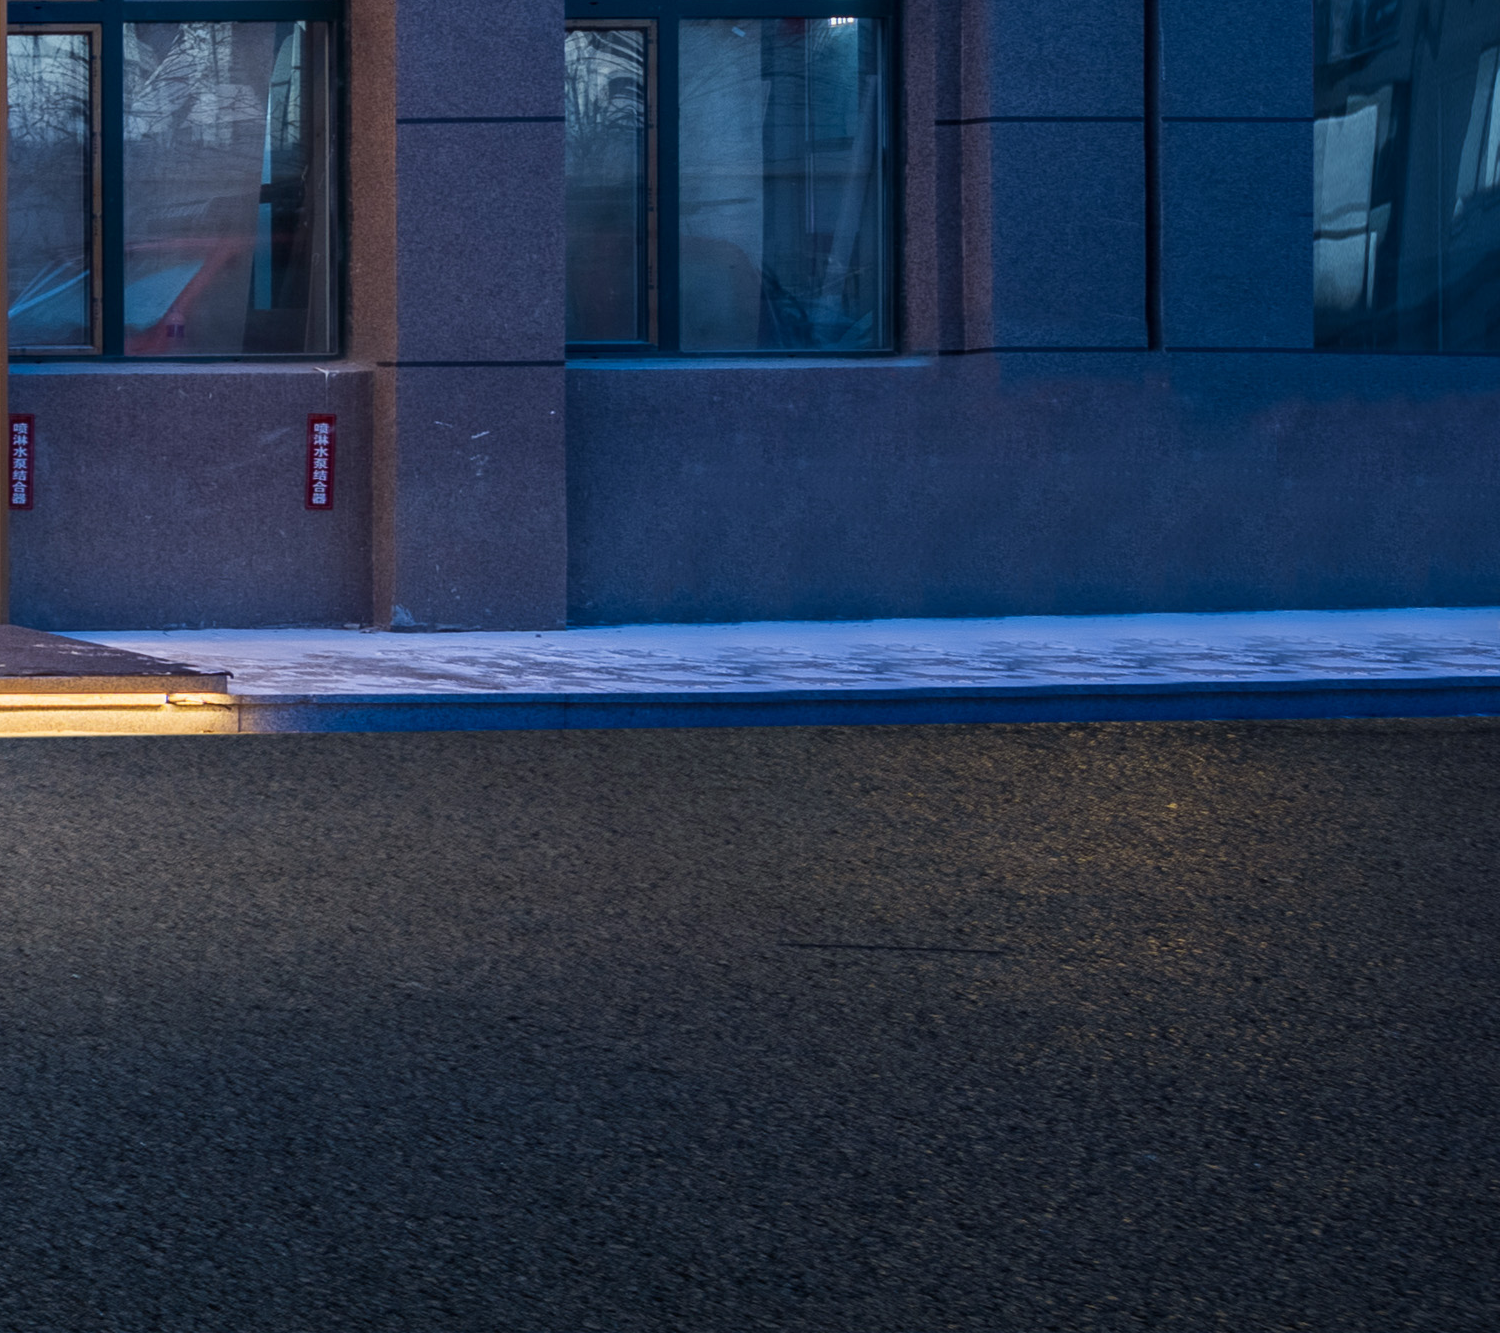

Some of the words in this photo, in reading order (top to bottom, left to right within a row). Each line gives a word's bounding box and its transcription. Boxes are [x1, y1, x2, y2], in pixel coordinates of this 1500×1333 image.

[12, 422, 28, 504] 喷淋水泵结合器
[312, 422, 329, 504] 喷淋水泵结合器
